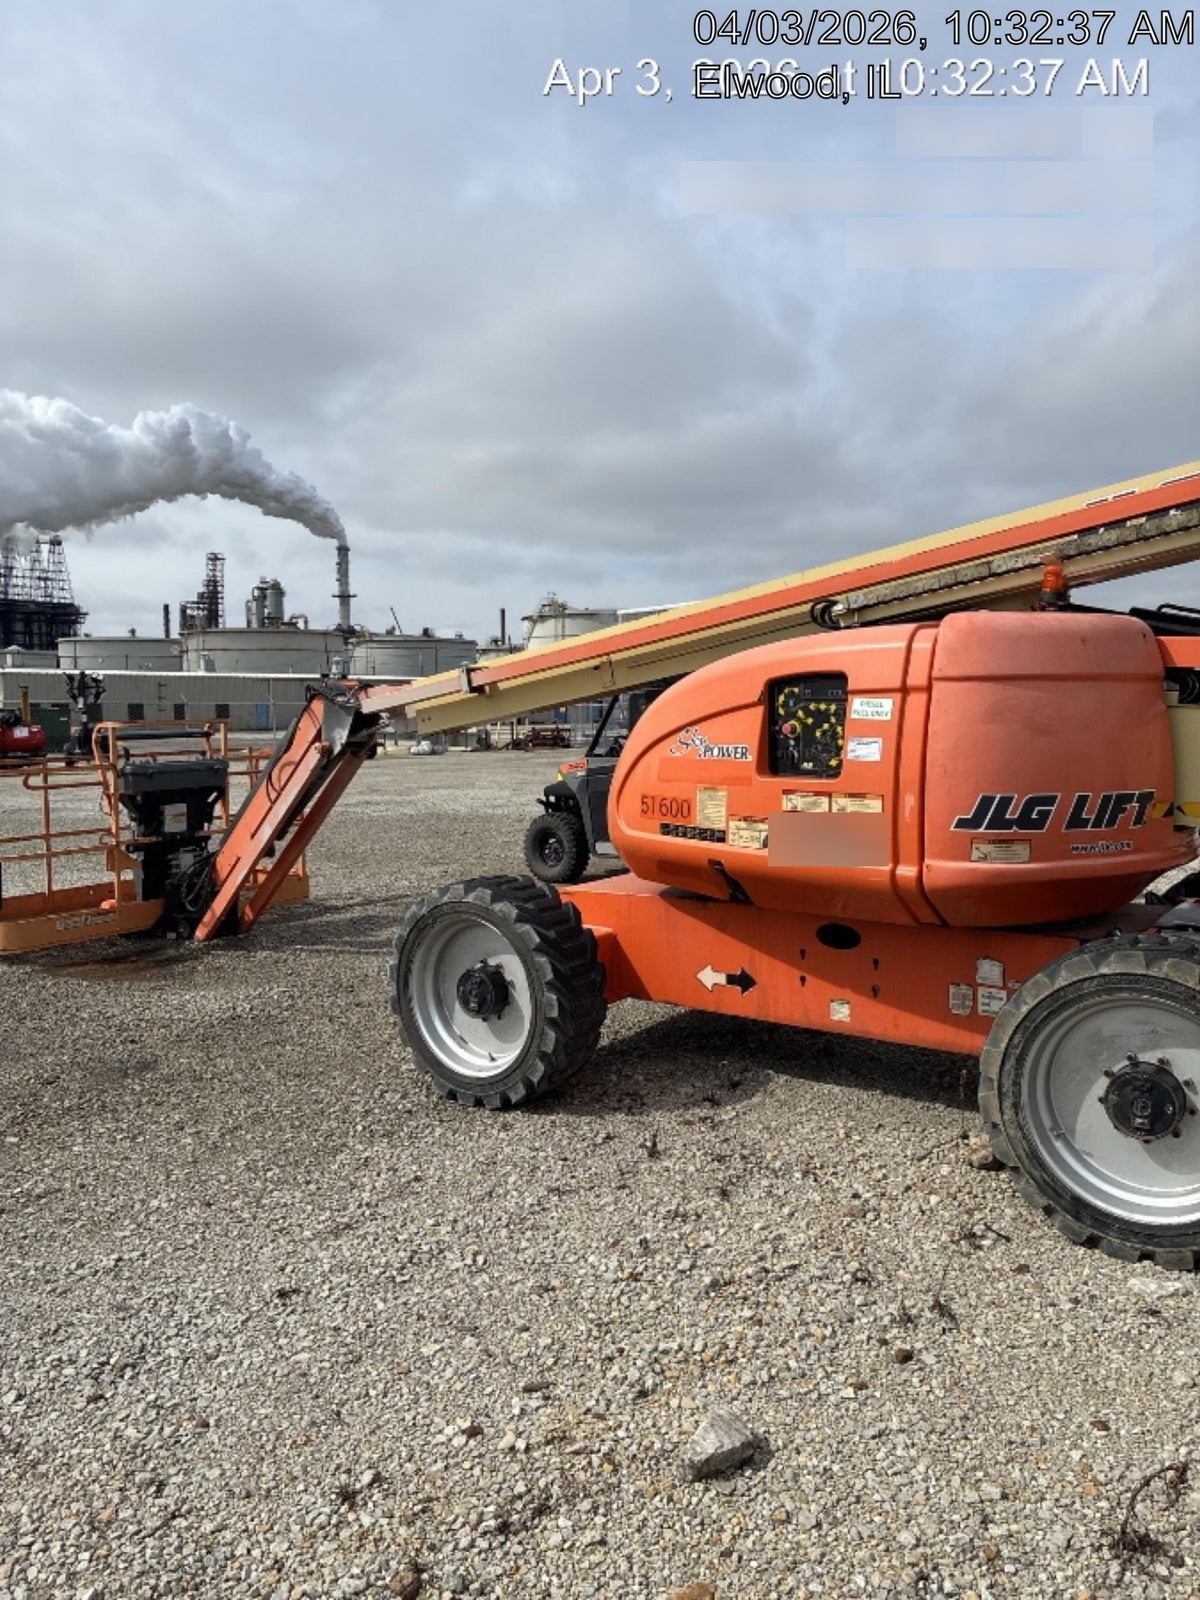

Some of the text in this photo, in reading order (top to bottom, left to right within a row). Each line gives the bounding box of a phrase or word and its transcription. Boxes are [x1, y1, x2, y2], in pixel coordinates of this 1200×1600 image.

[701, 744, 751, 760] POWER
[641, 795, 691, 819] 51600
[950, 789, 1157, 833] JLG LIFT
